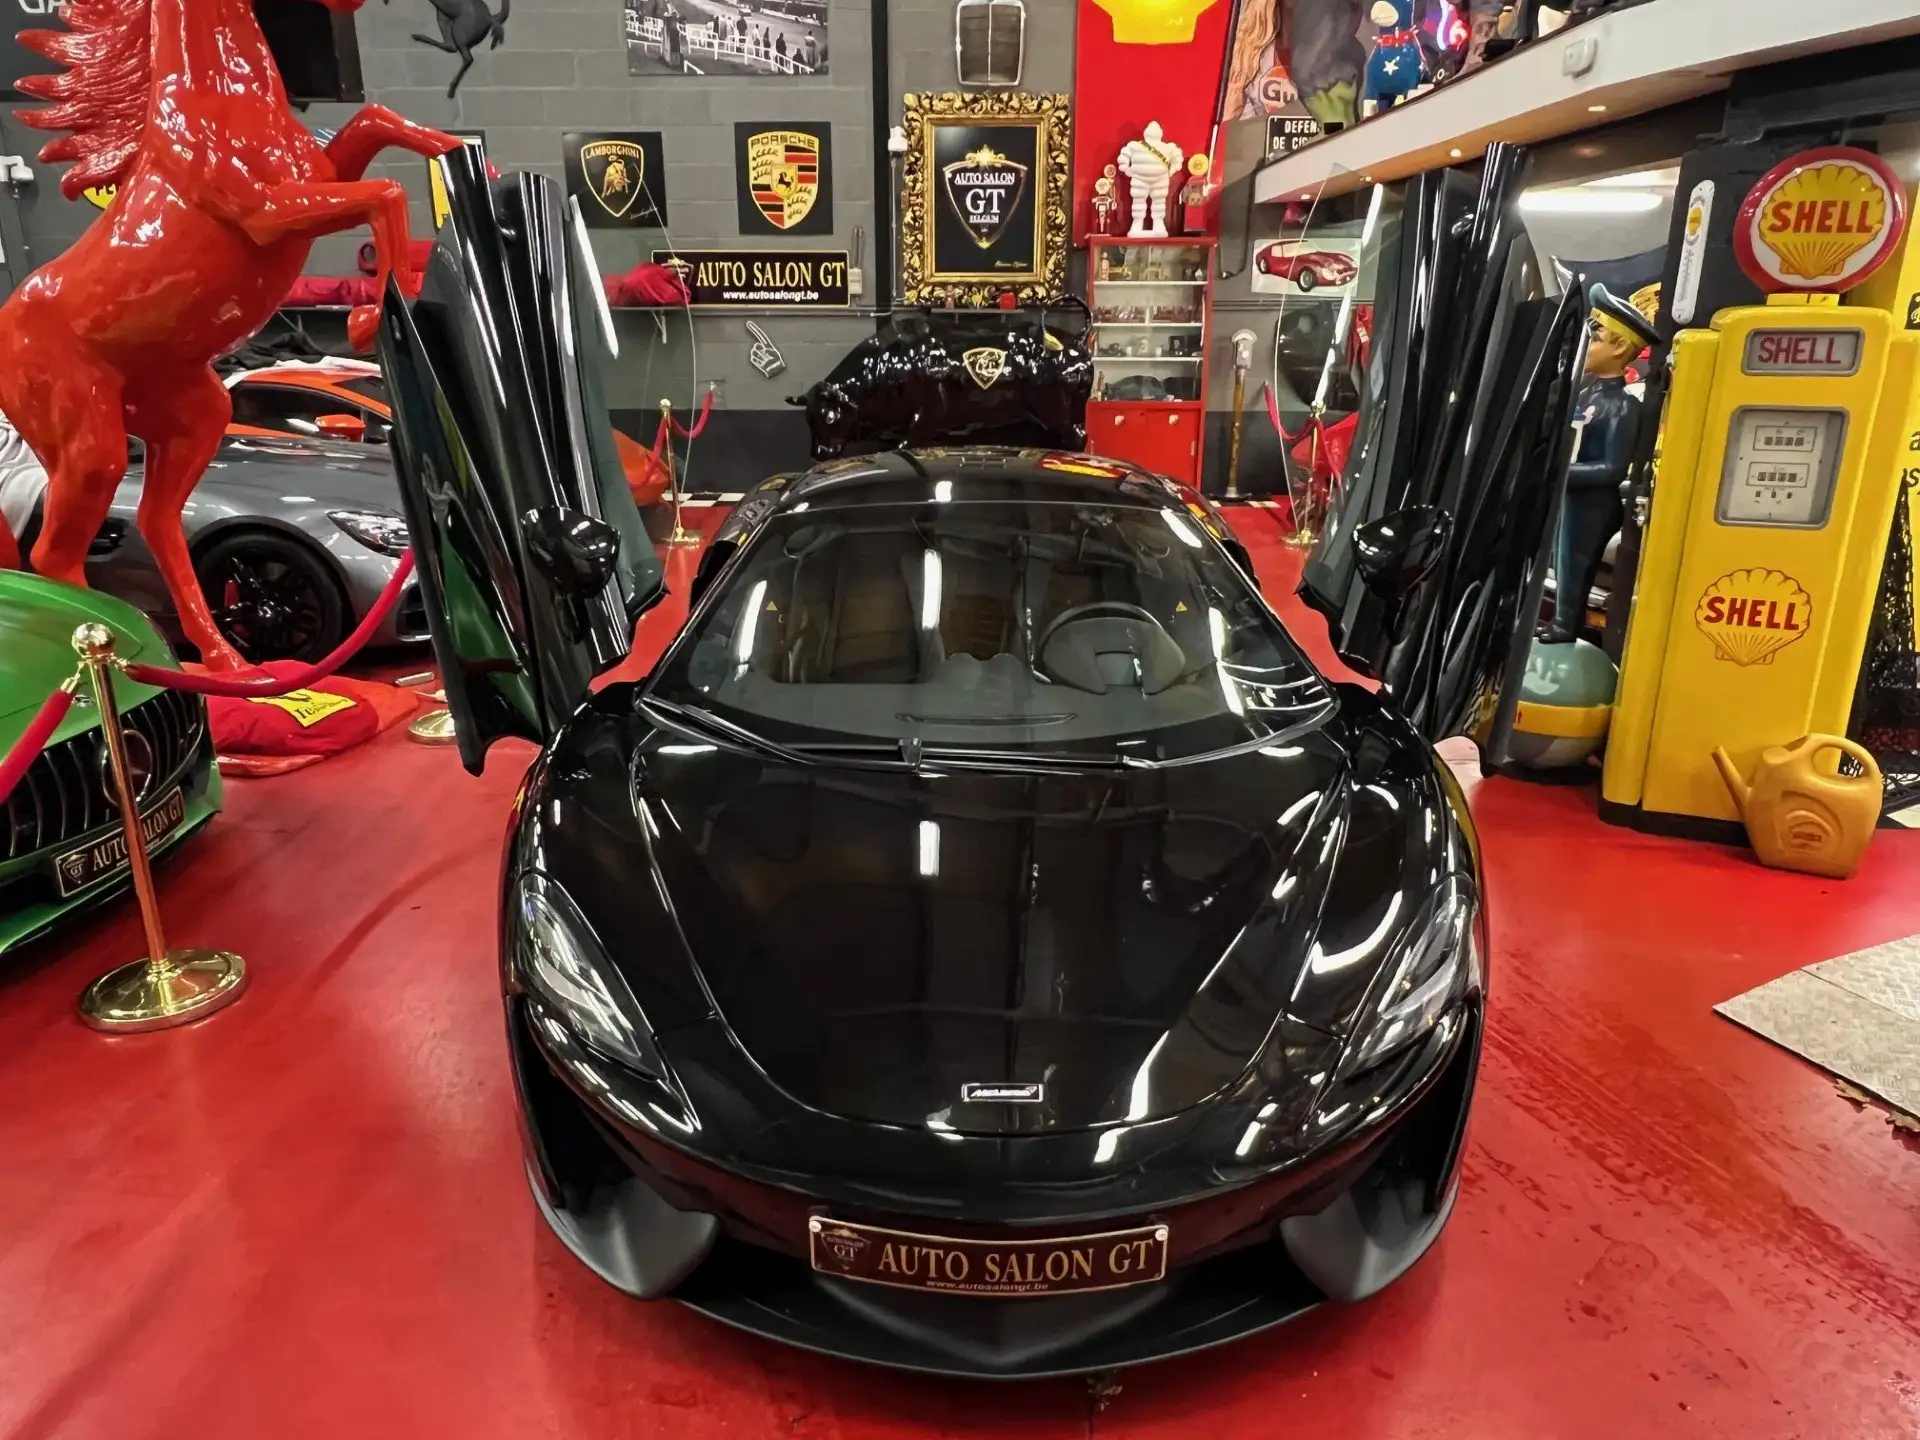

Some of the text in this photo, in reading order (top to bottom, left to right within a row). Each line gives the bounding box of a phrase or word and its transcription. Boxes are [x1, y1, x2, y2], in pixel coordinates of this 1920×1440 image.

[750, 134, 816, 149] PORSCHE
[1273, 136, 1286, 150] DE
[585, 145, 640, 159] LAMBORGHINI
[954, 172, 1016, 185] AUTO SALON
[965, 188, 1006, 214] GT
[1767, 200, 1874, 233] SHELL
[696, 261, 845, 287] AUTO SALON GT
[723, 290, 819, 302] www.autosalongt.be
[1757, 336, 1842, 364] SHELL
[1703, 596, 1800, 631] SHELL
[878, 1238, 1154, 1283] AUTO SALON GT
[925, 1279, 1049, 1292] www.autosalongt.be
